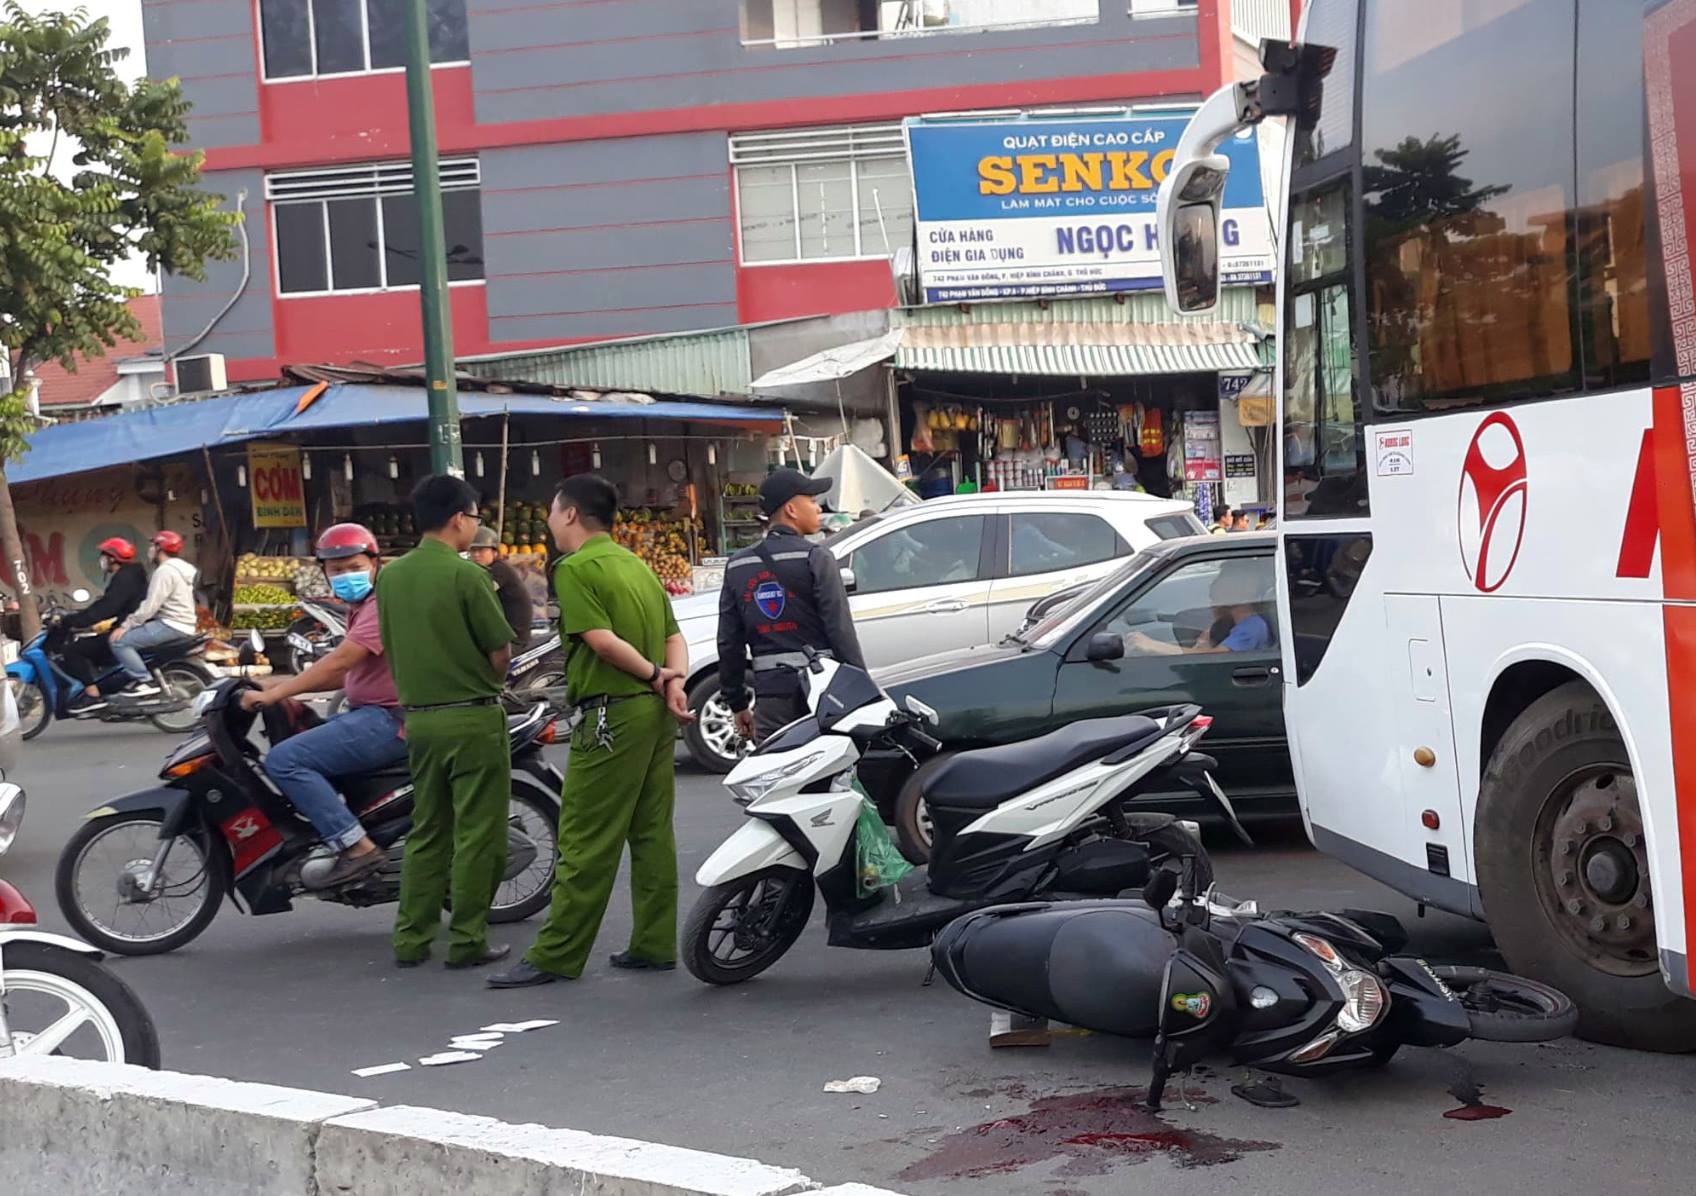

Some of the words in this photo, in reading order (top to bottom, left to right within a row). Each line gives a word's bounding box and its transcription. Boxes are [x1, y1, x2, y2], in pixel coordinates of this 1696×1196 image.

[1003, 136, 1047, 150] QUẠT
[1051, 133, 1090, 149] ĐIỆN
[1093, 133, 1128, 146] CAO
[1132, 128, 1165, 145] CẤP
[1066, 196, 1095, 207] CHO
[929, 227, 956, 244] CỬA
[959, 226, 994, 243] HÀNG
[1056, 223, 1134, 259] NGỌC
[931, 247, 961, 264] ĐIỆN
[965, 249, 986, 262] GIA
[255, 461, 301, 502] CƠM
